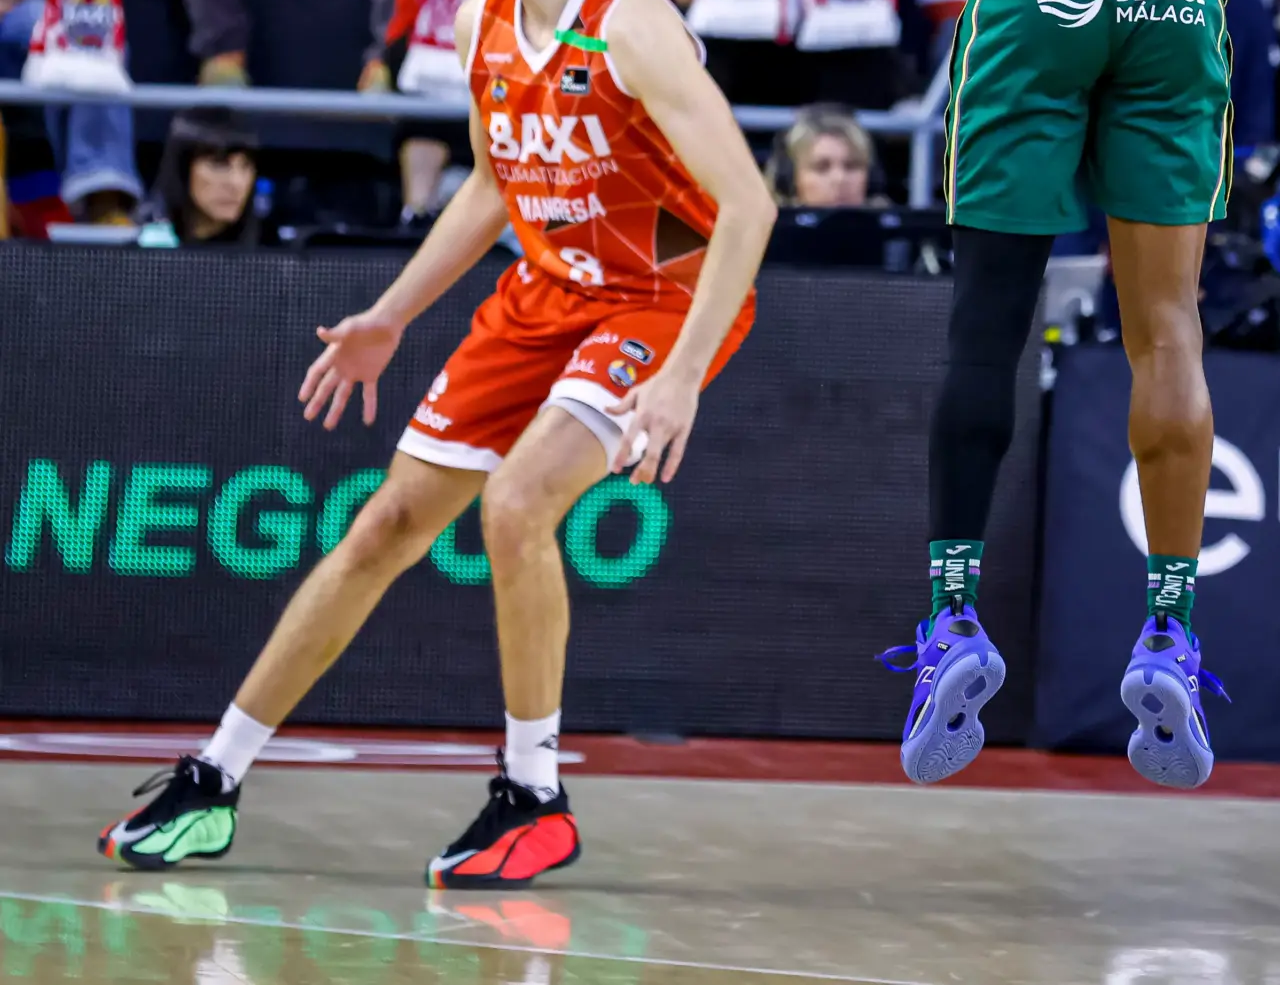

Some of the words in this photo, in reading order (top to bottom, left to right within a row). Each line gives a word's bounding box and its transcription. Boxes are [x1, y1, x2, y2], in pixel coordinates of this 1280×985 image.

[1116, 1, 1206, 27] MÁLAGA
[489, 111, 612, 164] BAXI
[516, 192, 608, 224] MANRESA
[4, 458, 672, 589] NEGO
